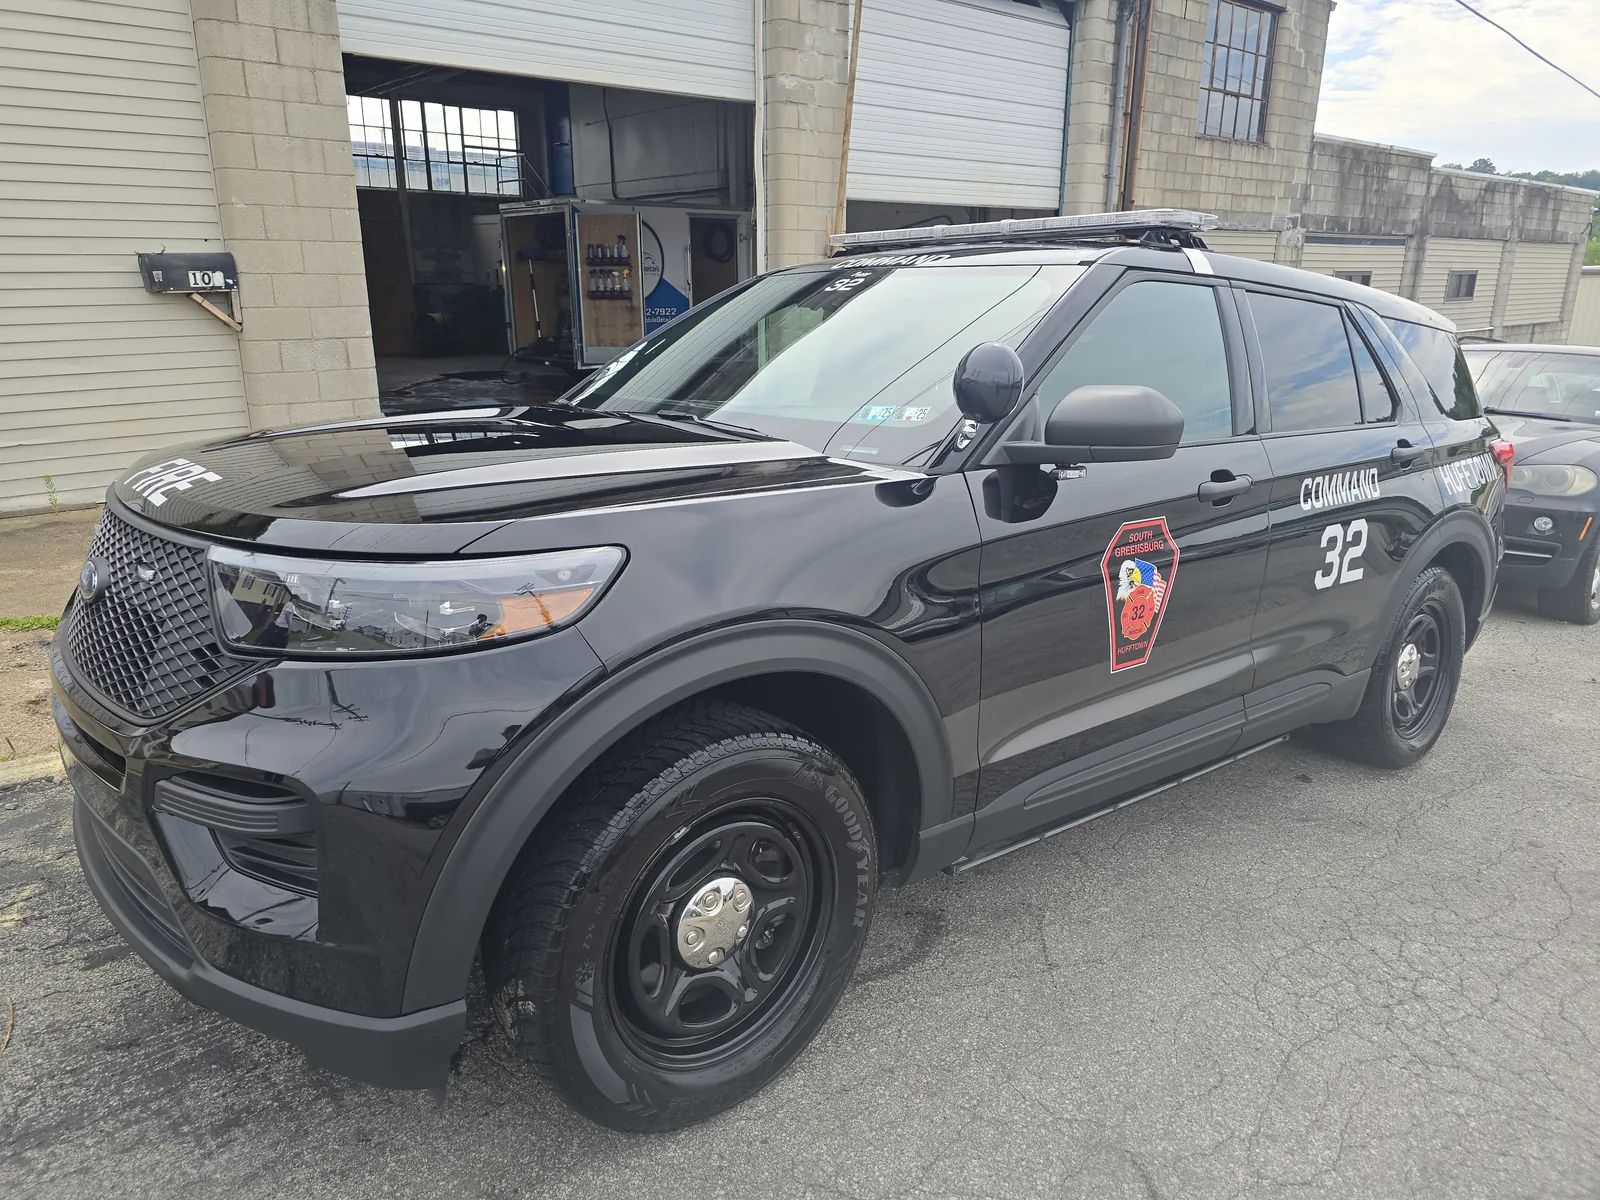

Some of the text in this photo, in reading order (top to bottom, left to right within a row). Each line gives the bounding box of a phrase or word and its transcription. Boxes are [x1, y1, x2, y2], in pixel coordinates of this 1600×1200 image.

[191, 272, 212, 286] 10
[824, 278, 865, 292] 32
[123, 457, 224, 507] FIRE
[1300, 467, 1381, 511] COMMAND
[1128, 530, 1153, 543] SOUTH
[1115, 541, 1165, 558] GREENSBURG
[1314, 518, 1369, 590] 32
[1131, 604, 1146, 621] 32
[1117, 640, 1149, 655] HUFFTOWN
[824, 784, 871, 928] GOODYEAR
